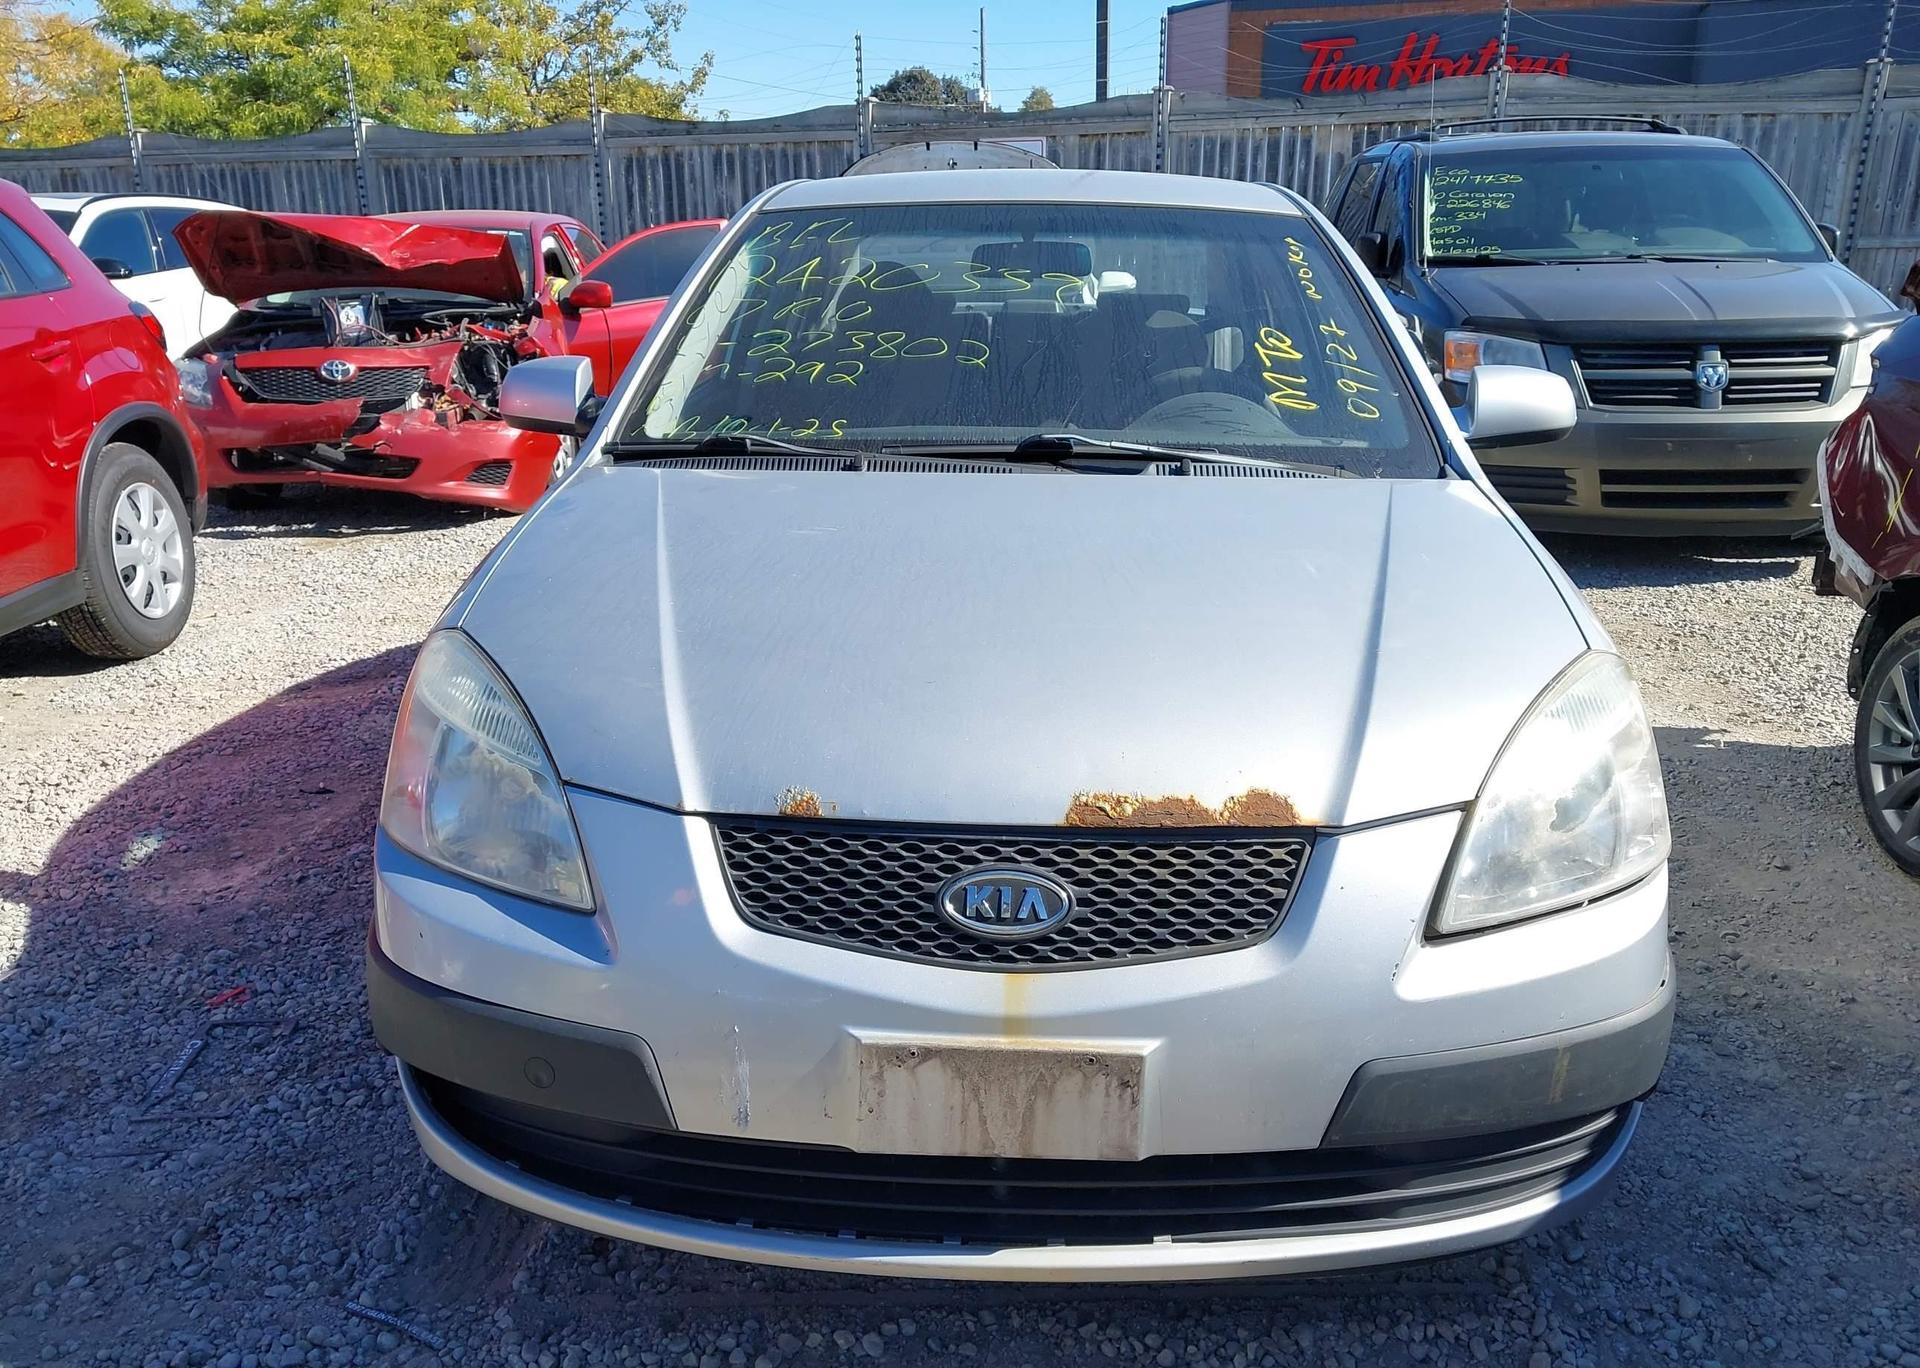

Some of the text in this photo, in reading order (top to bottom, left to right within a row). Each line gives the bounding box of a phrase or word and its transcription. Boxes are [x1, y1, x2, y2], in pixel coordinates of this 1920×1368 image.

[1302, 37, 1382, 94] Tim
[1449, 190, 1515, 199] Caravan
[964, 884, 1049, 920] KIA
